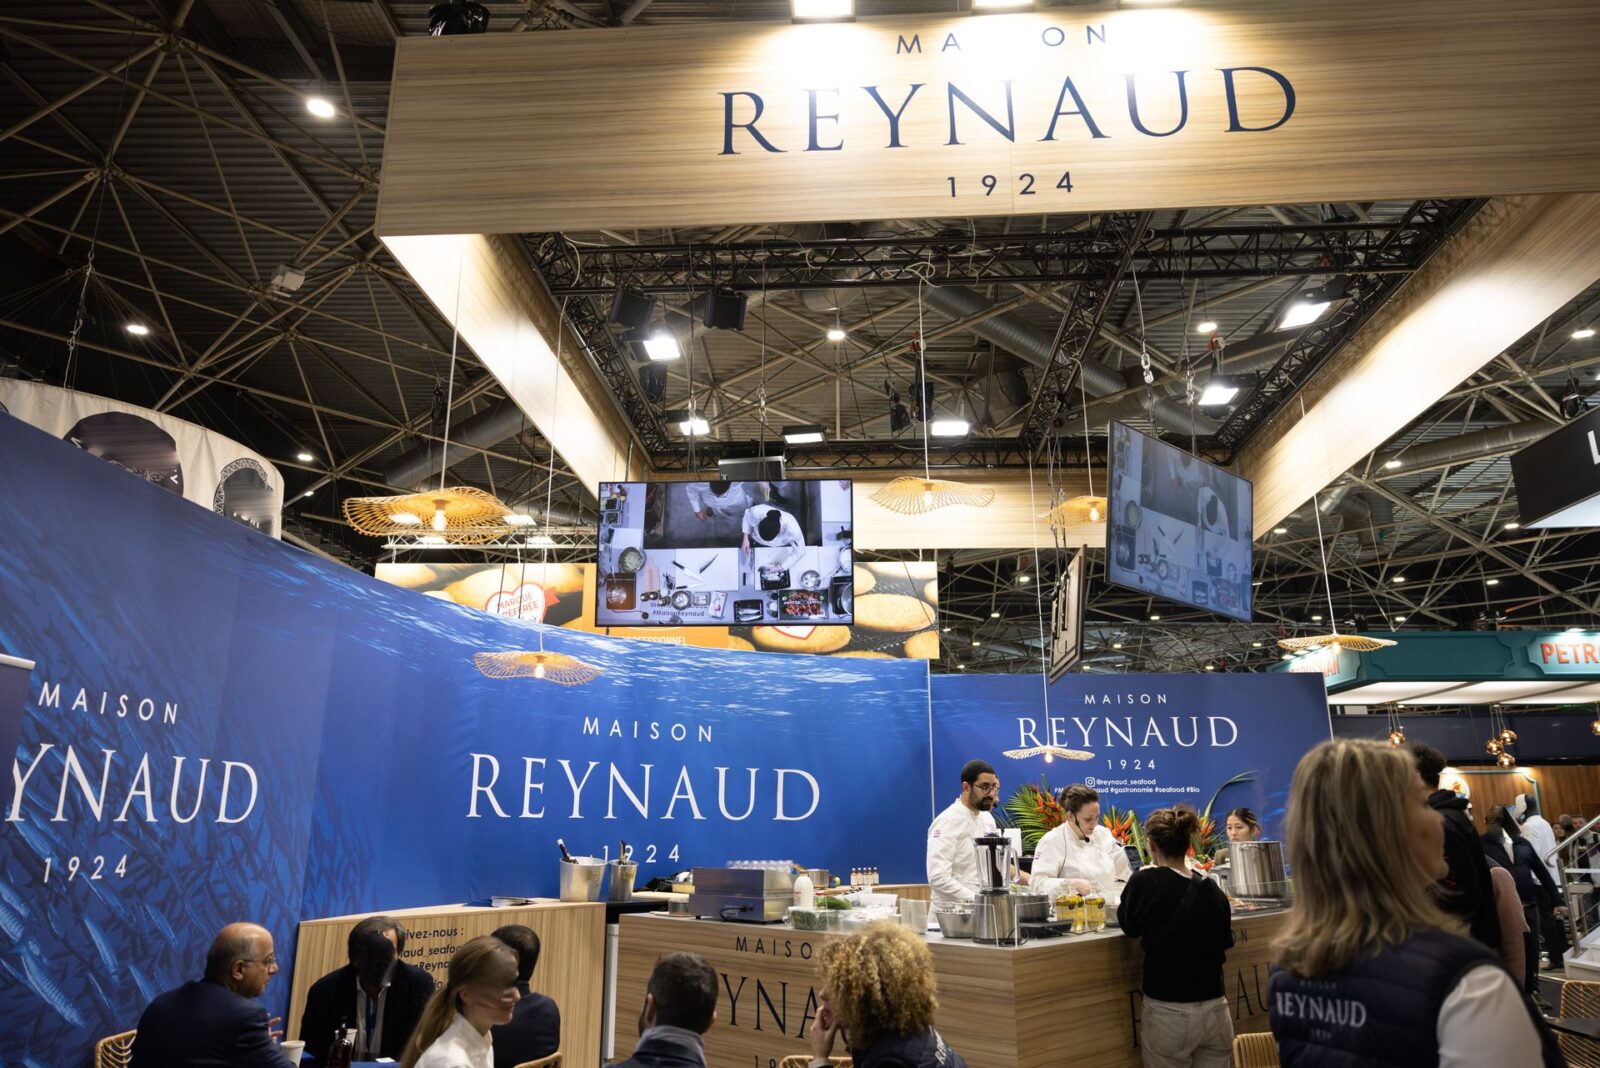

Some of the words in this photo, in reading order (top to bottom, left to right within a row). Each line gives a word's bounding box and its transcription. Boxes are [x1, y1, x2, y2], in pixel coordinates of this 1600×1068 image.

[896, 24, 1107, 54] MAON
[717, 66, 1297, 156] REYNAUD
[946, 171, 1074, 198] 1924
[1540, 641, 1600, 664] PETR
[38, 681, 178, 725] MAISON
[1084, 693, 1167, 704] MAISON
[582, 716, 713, 742] MAISON
[1016, 716, 1238, 748] REYNAUD
[1106, 759, 1156, 770] 1924
[5, 743, 258, 823] YNAUD
[465, 753, 820, 821] REYNAUD
[1096, 778, 1157, 787] @reynaud_seafood
[603, 844, 680, 864] 1924
[44, 855, 128, 883] 1924
[405, 928, 458, 940] ivez-nous
[735, 935, 813, 960] MAISO
